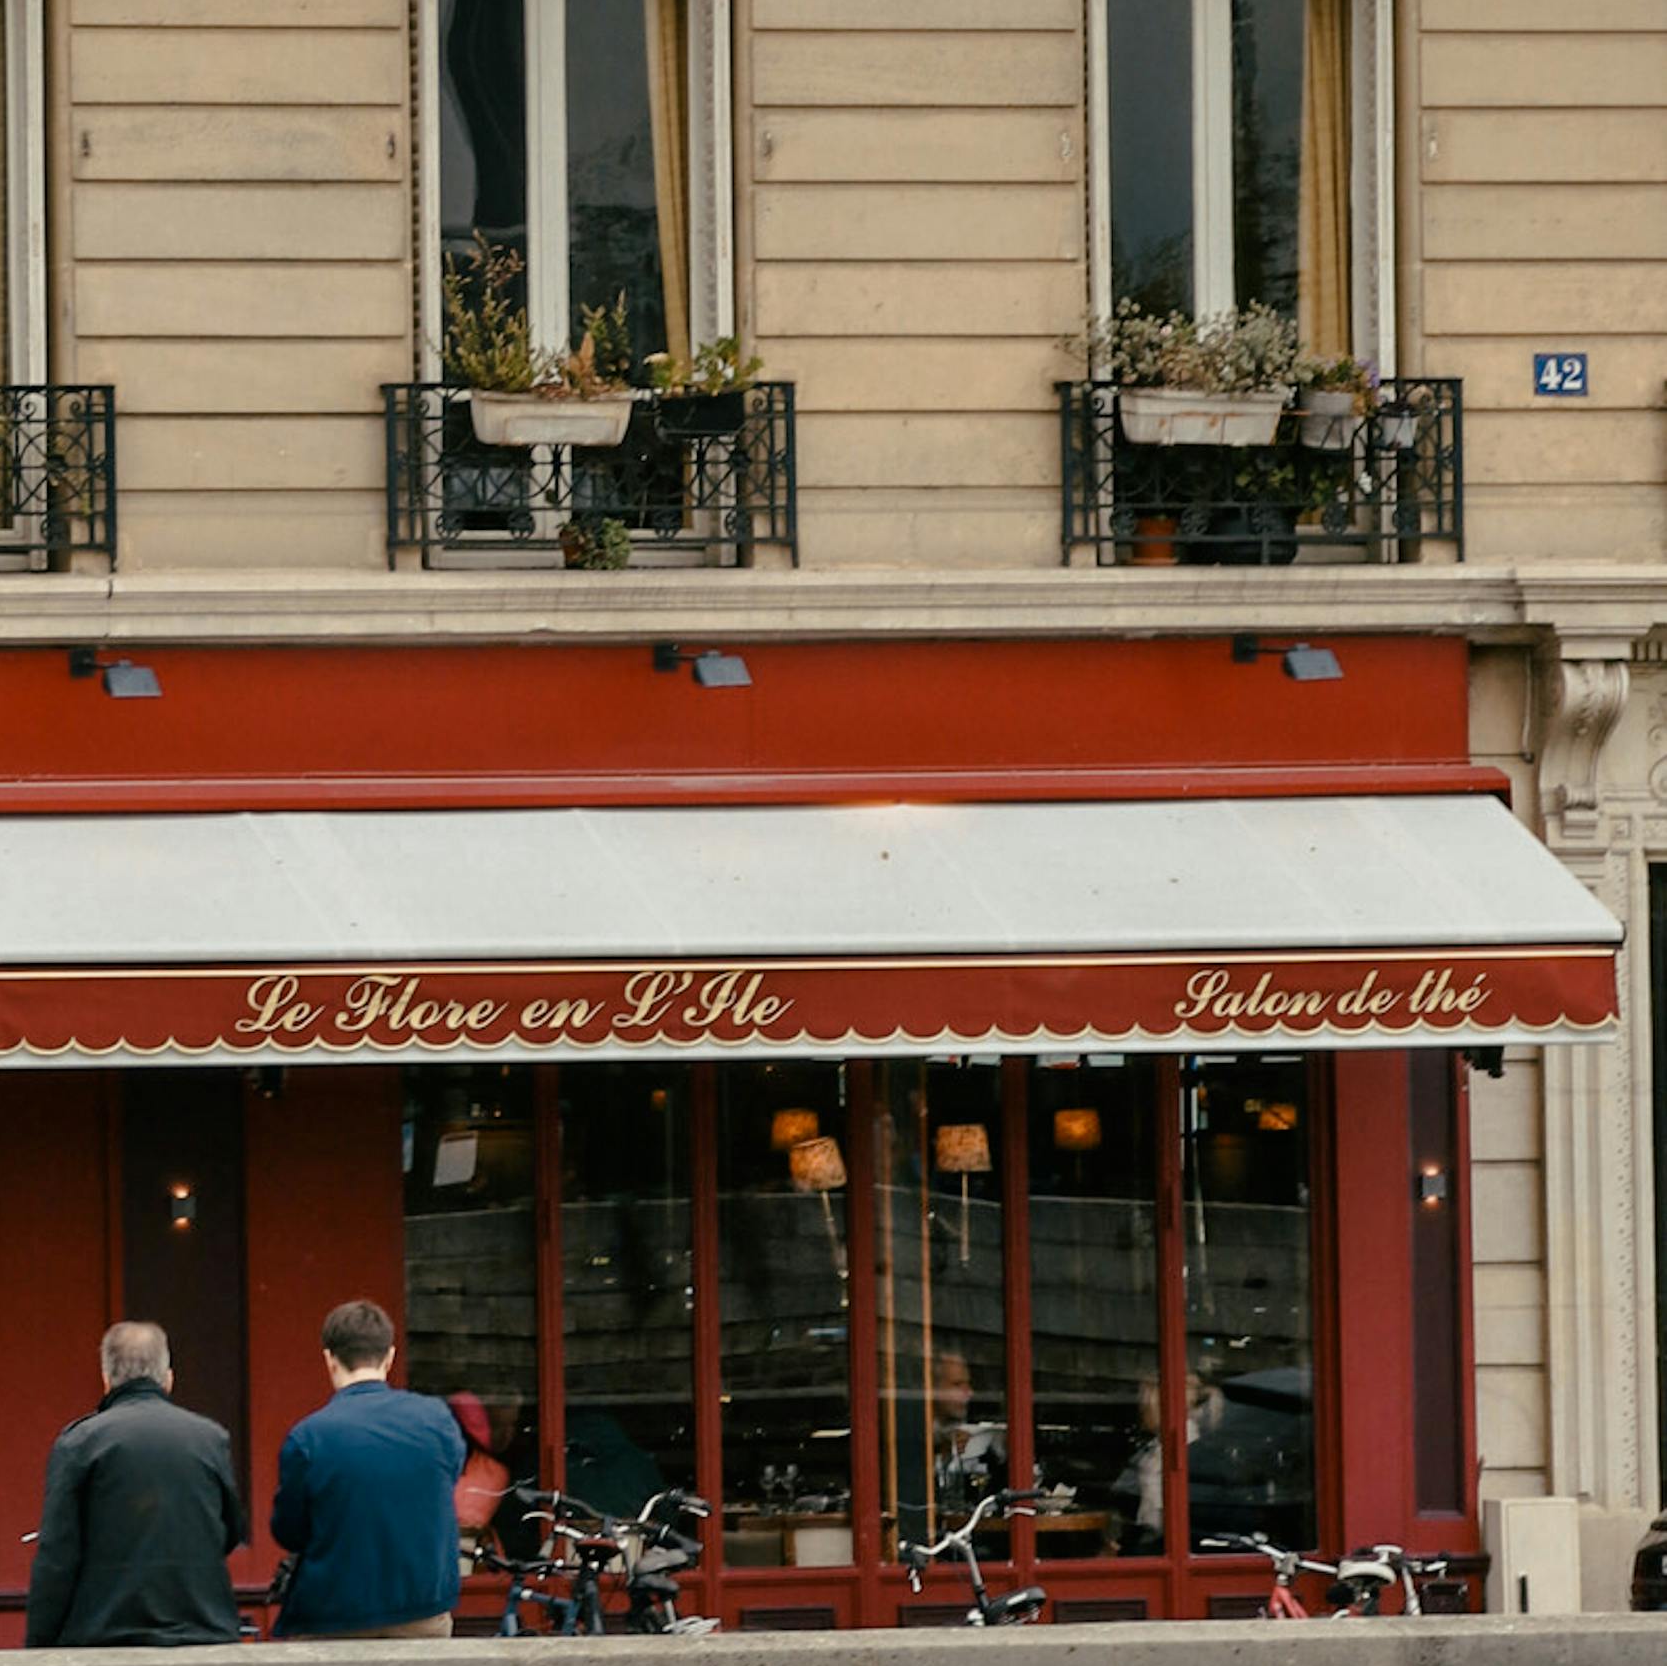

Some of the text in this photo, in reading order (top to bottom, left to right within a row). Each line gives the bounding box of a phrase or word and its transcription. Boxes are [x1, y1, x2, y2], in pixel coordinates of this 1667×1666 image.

[1539, 358, 1582, 390] 42
[234, 975, 325, 1032] Le
[335, 975, 508, 1031] Flore
[520, 998, 606, 1029] en
[1174, 968, 1492, 1018] Salon de thé
